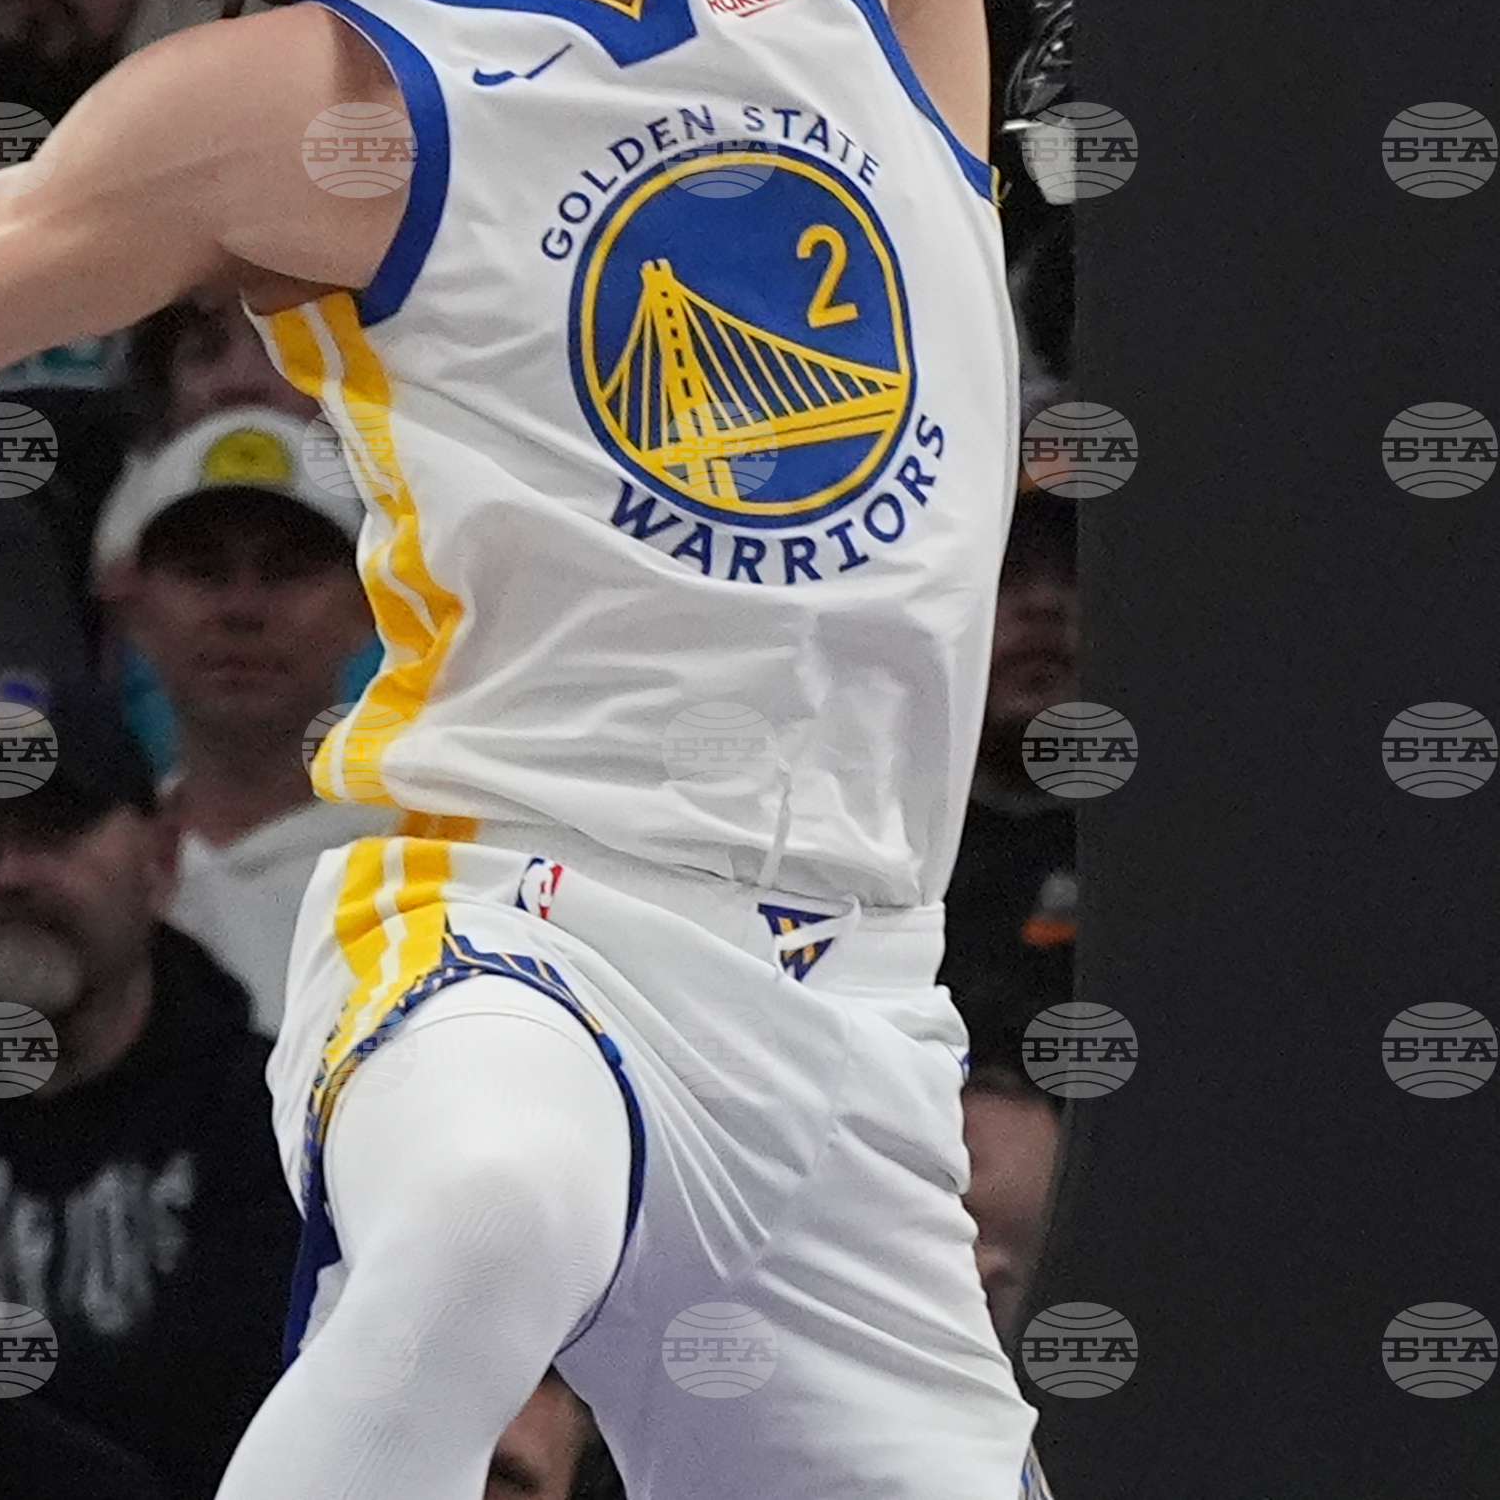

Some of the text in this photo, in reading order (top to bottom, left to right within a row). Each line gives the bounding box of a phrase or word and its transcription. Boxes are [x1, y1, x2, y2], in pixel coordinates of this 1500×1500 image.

[541, 104, 879, 261] GOLDEN STATE
[796, 224, 858, 328] 2
[610, 413, 945, 585] WARRIORS
